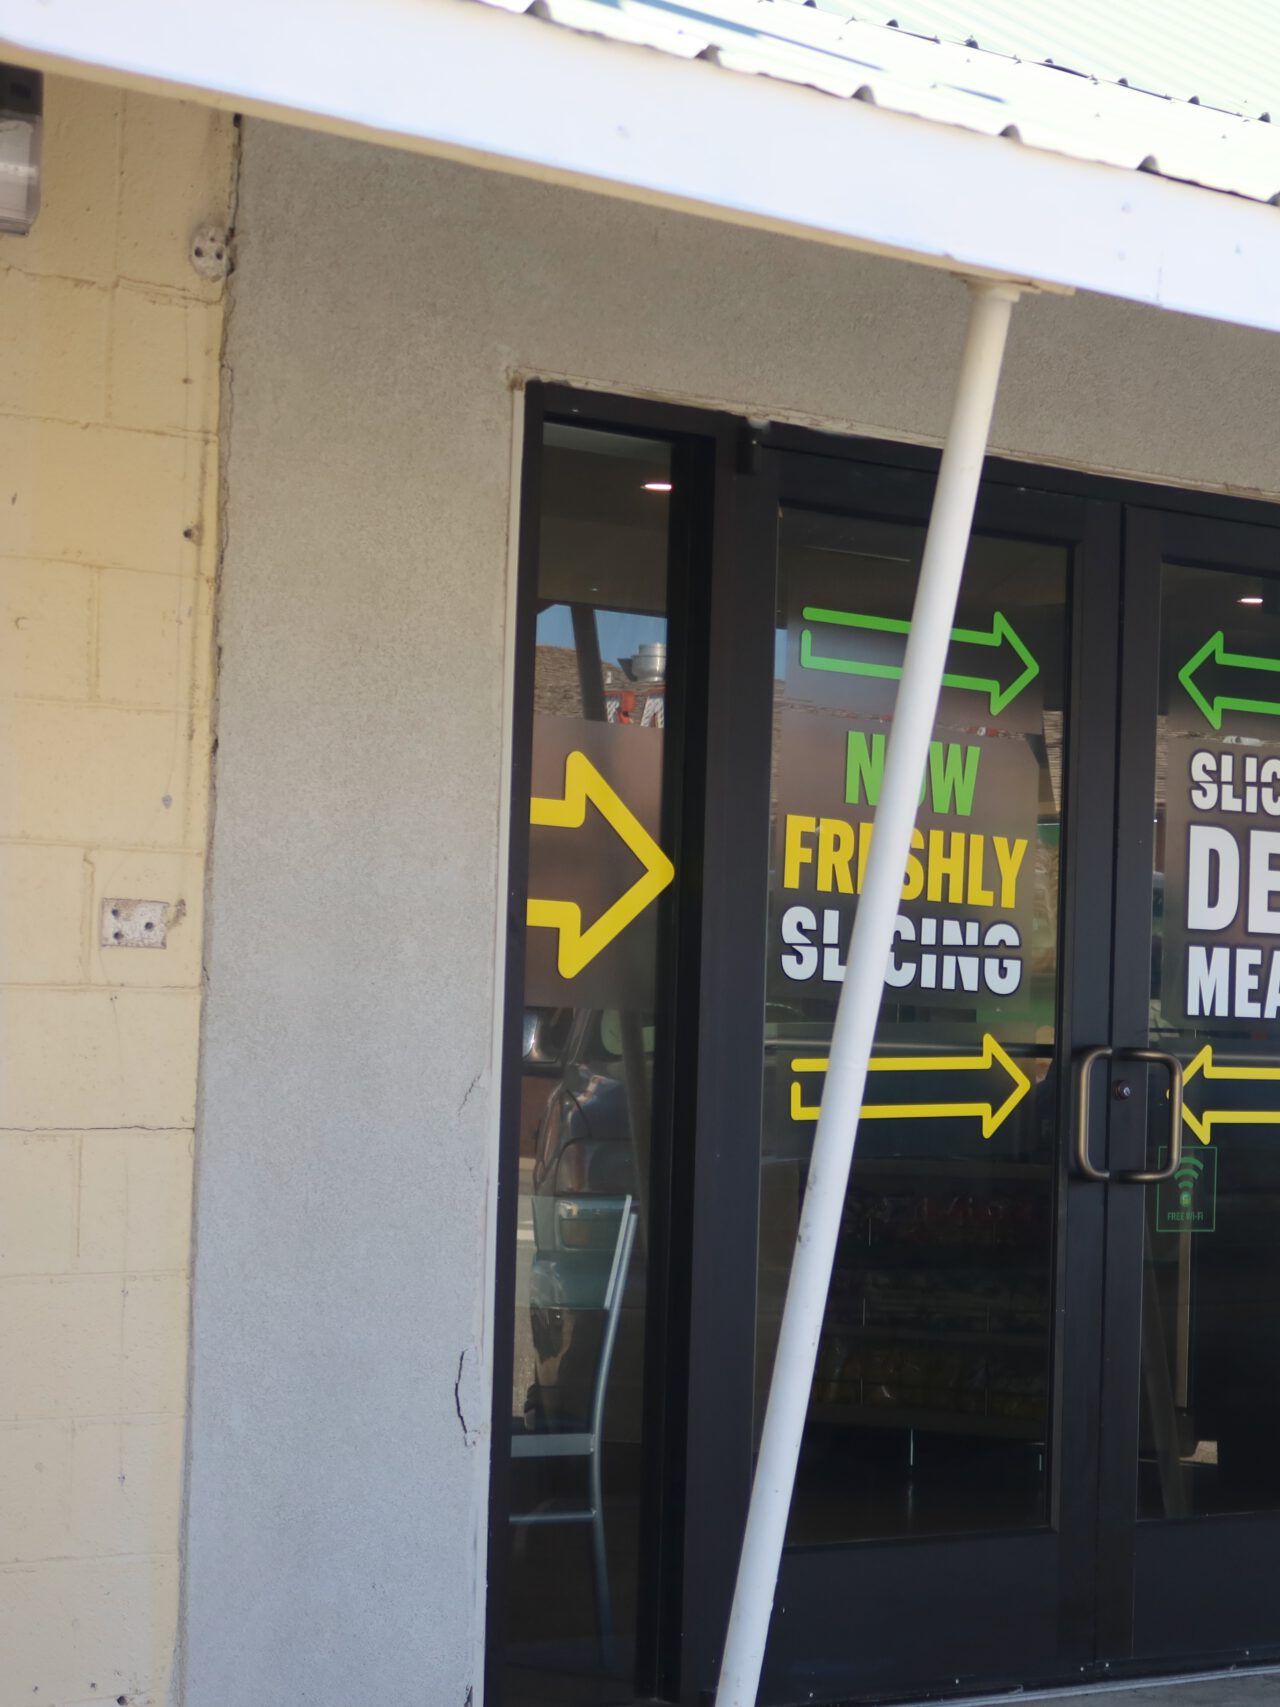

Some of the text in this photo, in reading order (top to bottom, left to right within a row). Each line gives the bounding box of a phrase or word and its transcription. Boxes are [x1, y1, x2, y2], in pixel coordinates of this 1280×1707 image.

[845, 730, 981, 817] NW
[780, 905, 1022, 996] SLCING
[1167, 1211, 1185, 1221] FREE
